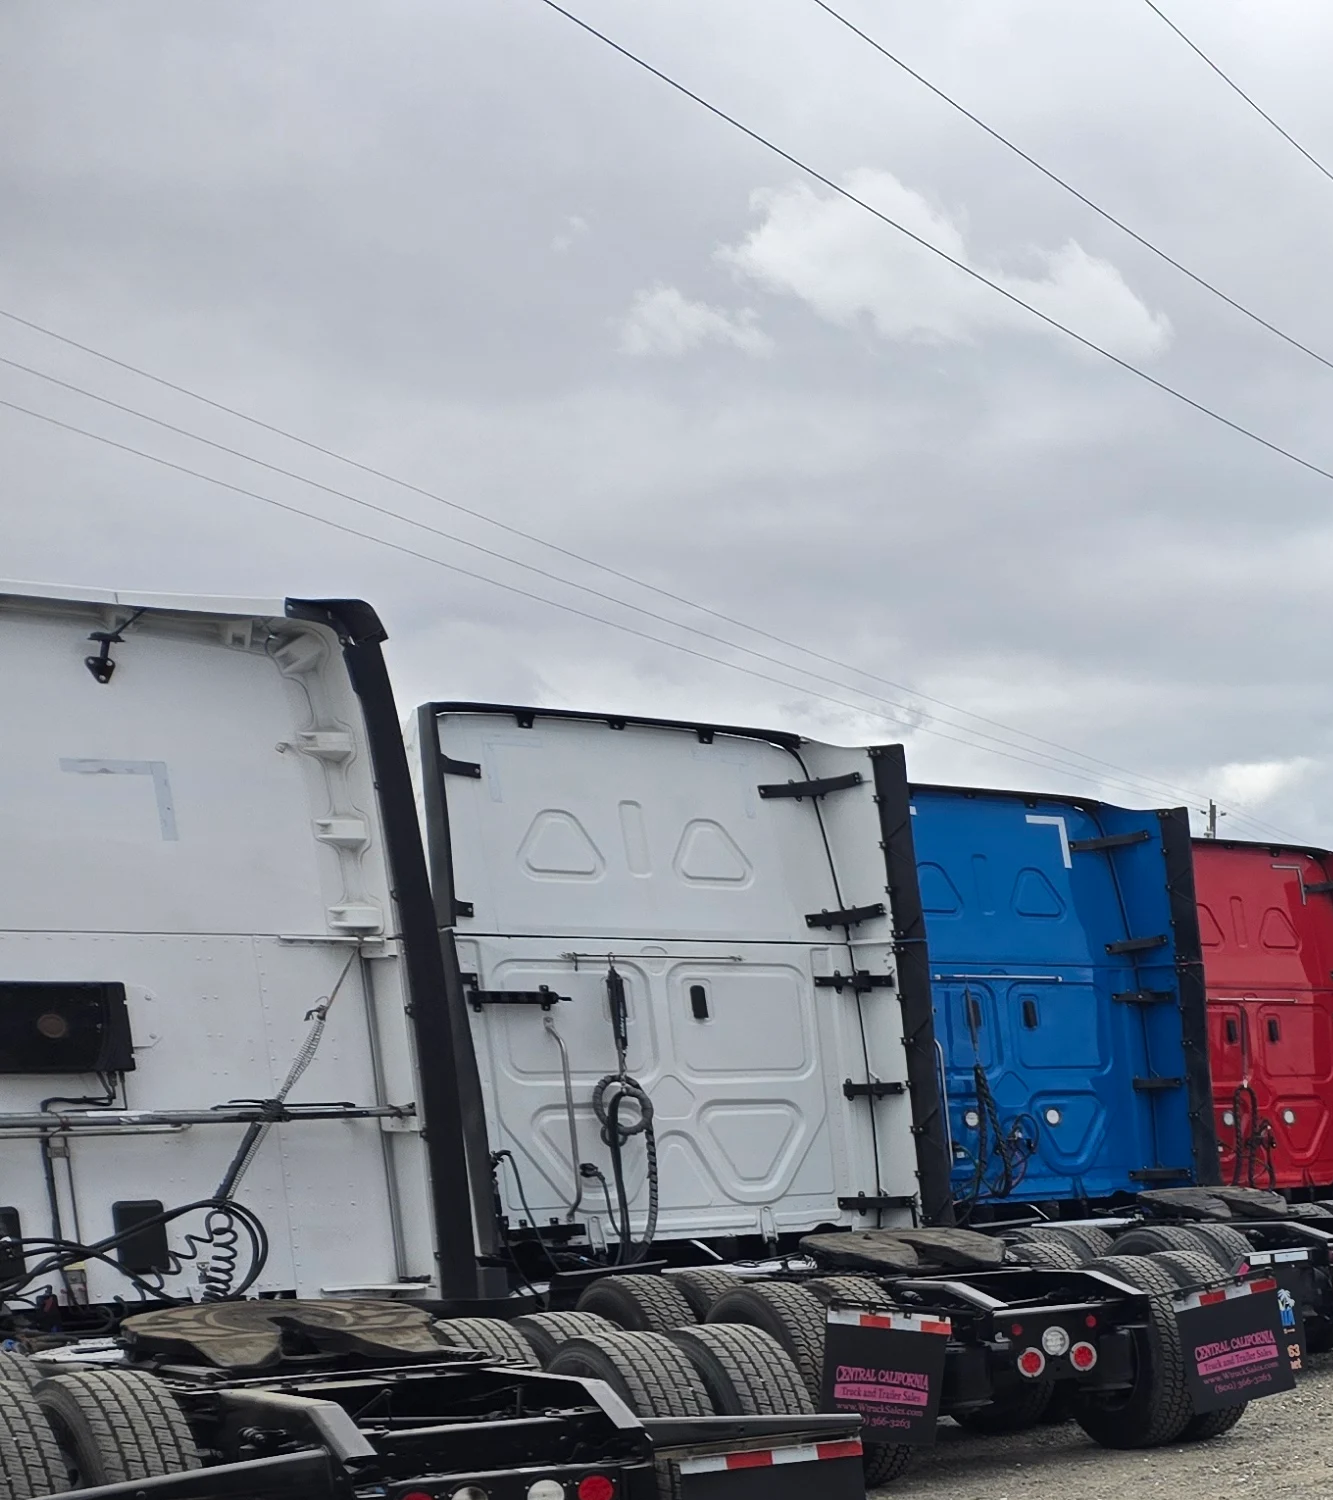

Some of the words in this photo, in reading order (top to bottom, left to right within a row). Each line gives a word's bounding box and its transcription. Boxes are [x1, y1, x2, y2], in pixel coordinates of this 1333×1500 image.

[1195, 1340, 1231, 1361] CENTRAL
[1231, 1329, 1276, 1349] CALIFORNIA
[1204, 1361, 1222, 1372] Truck
[1223, 1358, 1235, 1367] and
[1235, 1353, 1256, 1365] Trailer
[1256, 1349, 1273, 1358] Sales
[836, 1365, 877, 1382] CENTRAL
[878, 1370, 929, 1390] CALIFORNIA
[1238, 1373, 1272, 1389] 366-3263
[842, 1386, 862, 1398] Truck
[863, 1388, 876, 1398] and
[878, 1389, 902, 1401] Trailer
[902, 1391, 921, 1403] Sales
[871, 1417, 911, 1429] 366-3263
